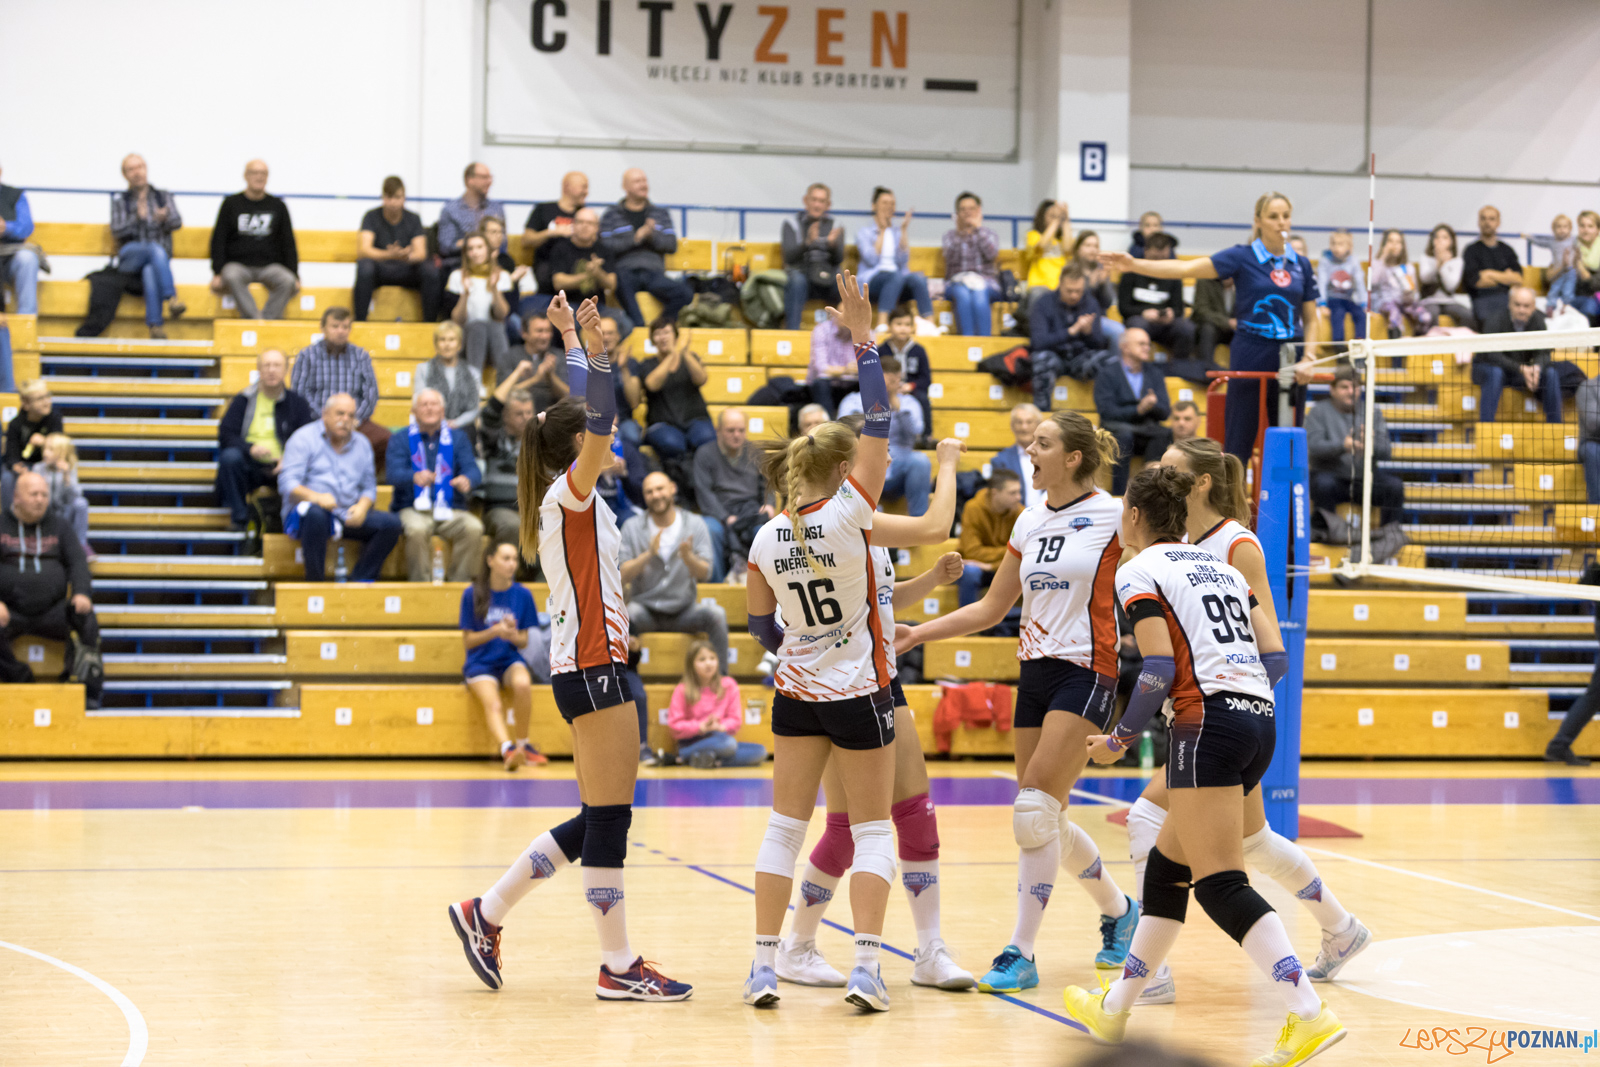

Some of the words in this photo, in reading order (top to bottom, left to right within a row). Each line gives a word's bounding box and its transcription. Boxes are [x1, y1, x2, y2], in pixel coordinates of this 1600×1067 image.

[531, 0, 908, 68] CITYZEN
[647, 65, 710, 82] WIĘCEJ
[758, 70, 802, 85] KLUB
[813, 72, 908, 90] SPORTOWY
[1085, 147, 1102, 176] B
[1036, 536, 1065, 563] 19
[774, 552, 836, 575] ENERGTYK
[1030, 580, 1070, 591] Enea
[787, 578, 843, 627] 16
[1202, 594, 1254, 644] 99
[598, 676, 608, 693] 7
[882, 710, 894, 730] 16
